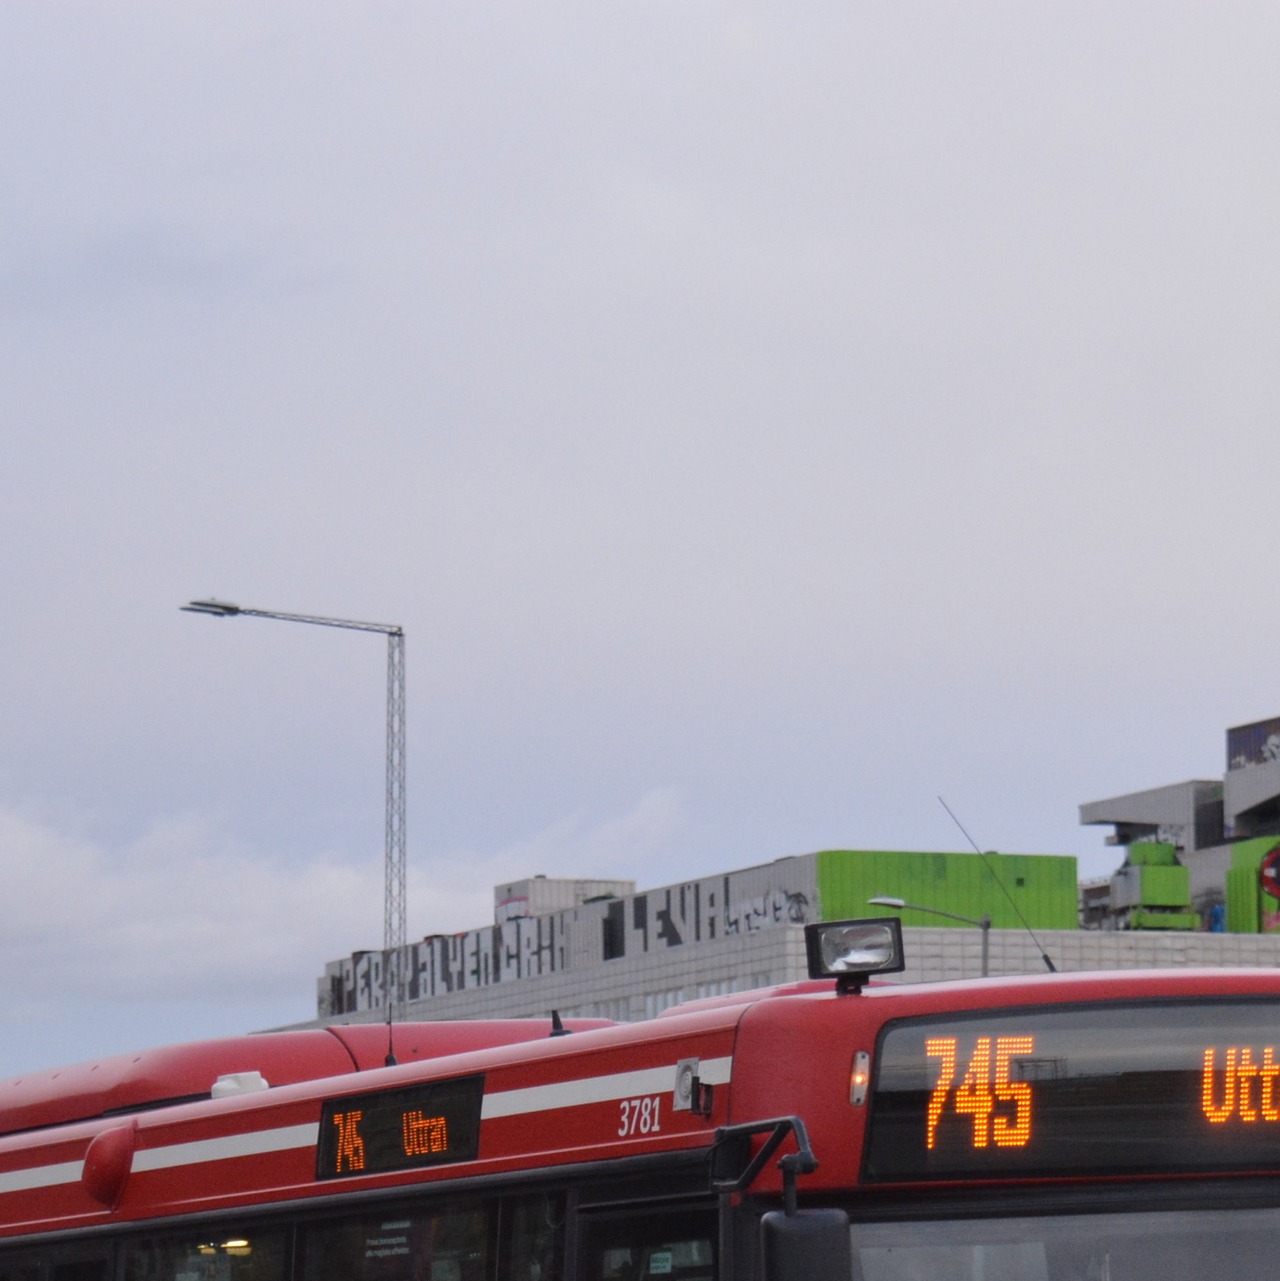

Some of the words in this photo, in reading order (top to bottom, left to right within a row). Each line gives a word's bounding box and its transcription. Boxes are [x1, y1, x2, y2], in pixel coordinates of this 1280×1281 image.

[333, 1110, 366, 1173] 745
[402, 1109, 448, 1157] Uttran
[618, 1097, 661, 1137] 3781
[925, 1036, 1034, 1150] 745
